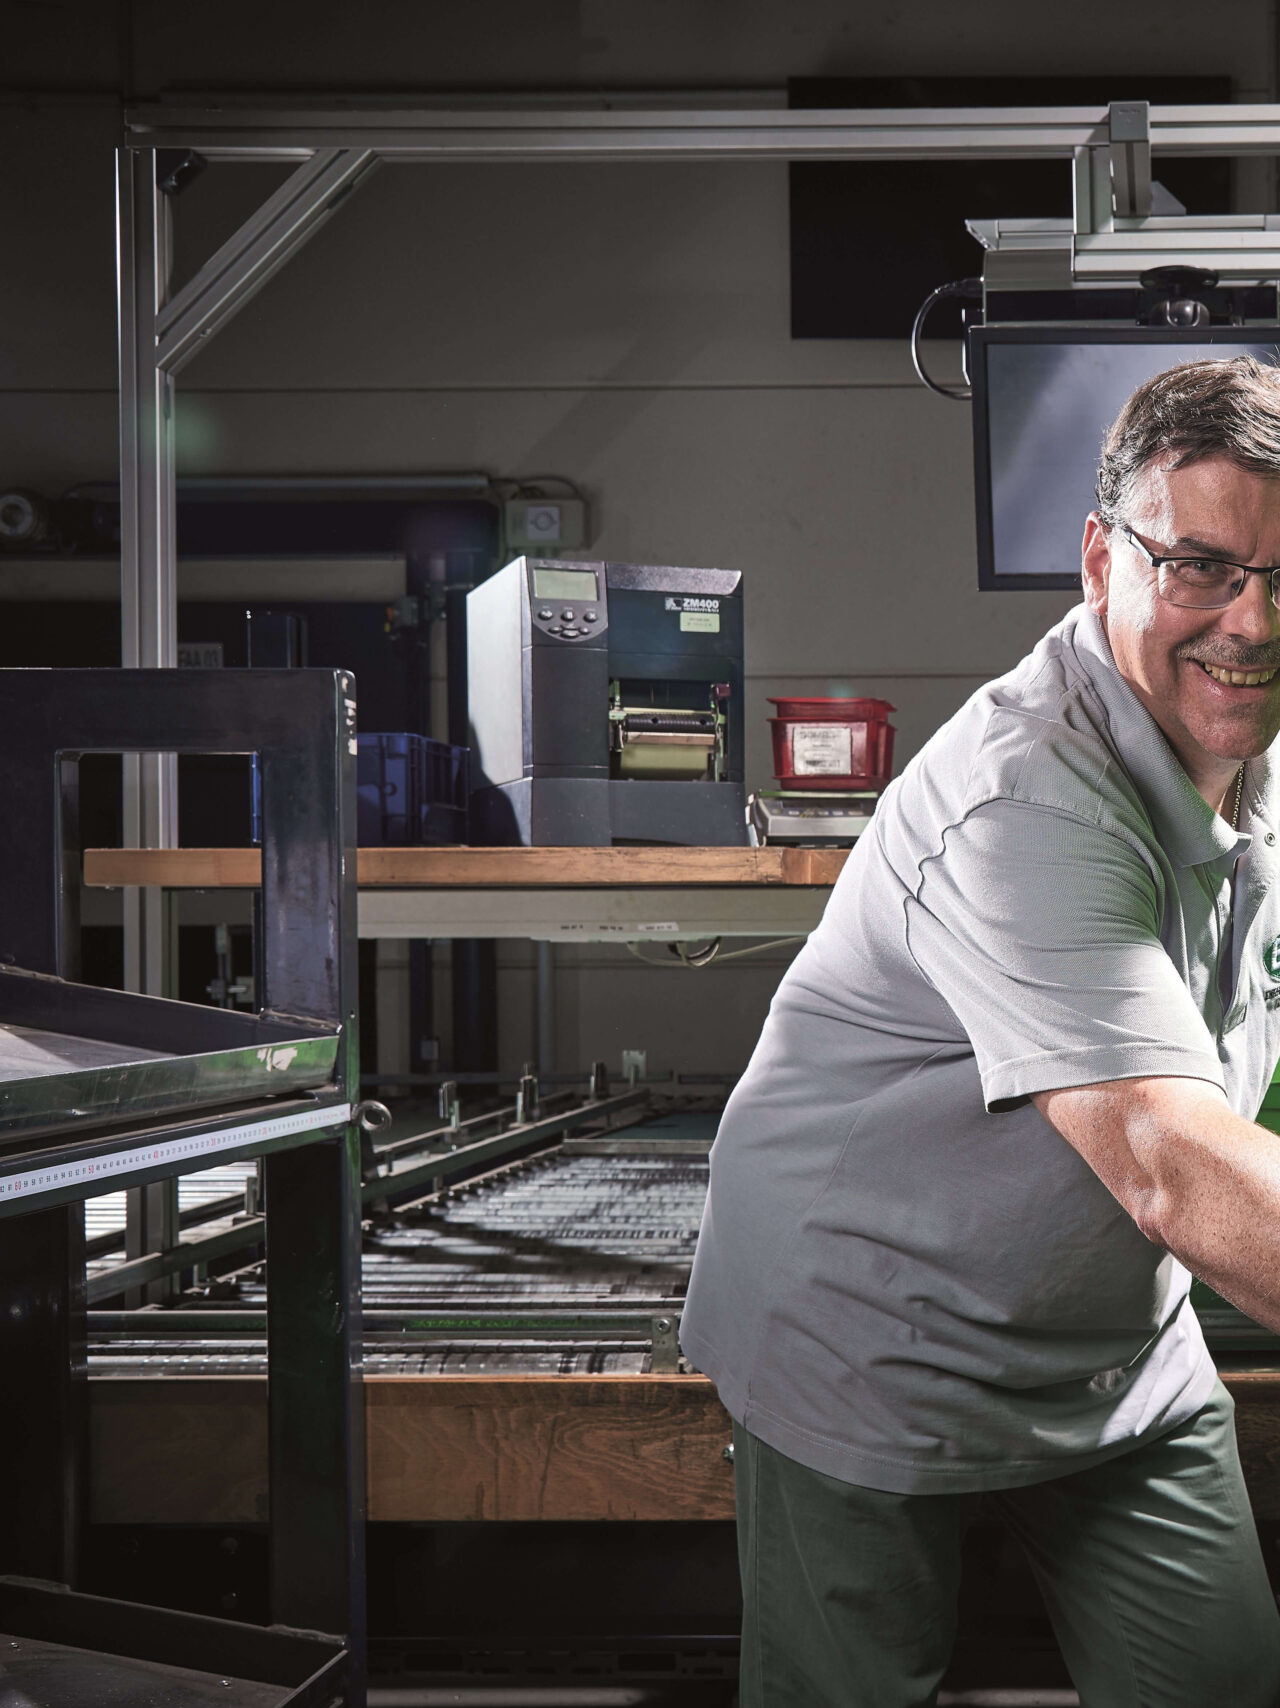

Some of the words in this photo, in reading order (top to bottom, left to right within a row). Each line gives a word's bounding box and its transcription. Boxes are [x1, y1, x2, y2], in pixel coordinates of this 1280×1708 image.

[683, 598, 719, 609] ZM400
[14, 1181, 22, 1191] 60
[88, 1164, 94, 1174] 50
